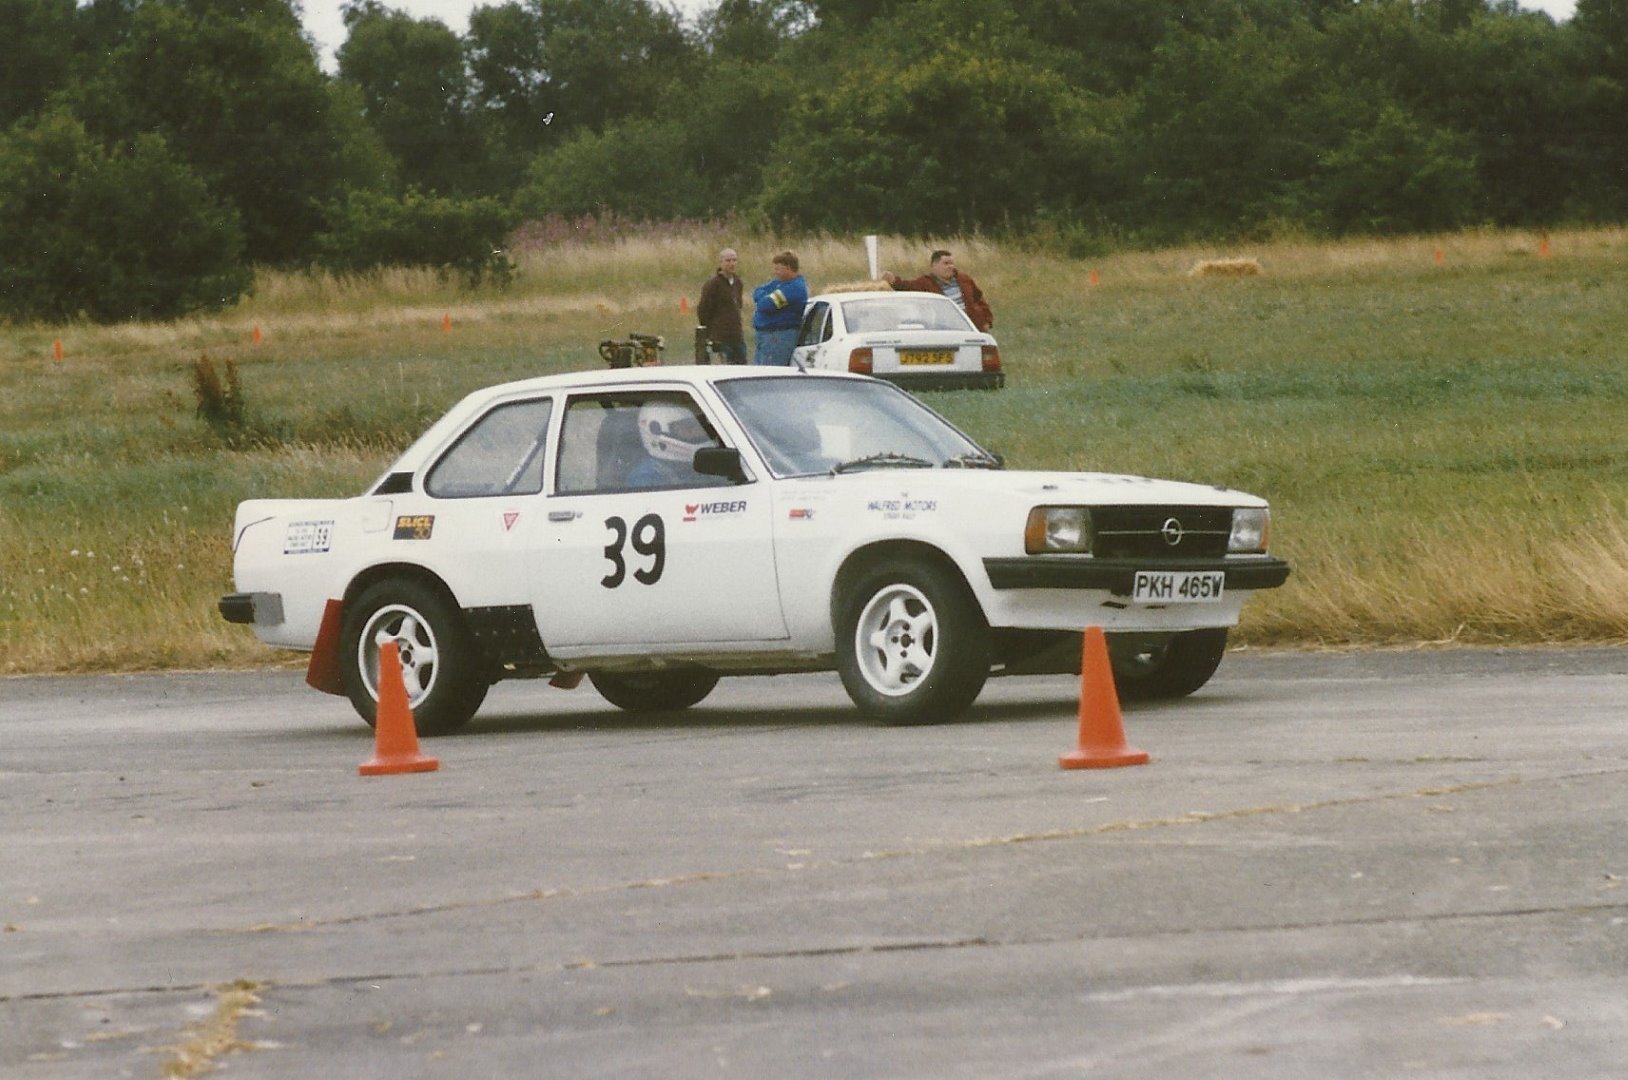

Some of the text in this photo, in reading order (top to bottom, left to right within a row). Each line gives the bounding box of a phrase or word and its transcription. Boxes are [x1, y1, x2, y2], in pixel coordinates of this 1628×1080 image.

[701, 501, 747, 514] WEBER
[904, 500, 937, 511] MOTORS
[600, 513, 666, 589] 39
[1136, 575, 1223, 598] PKH 465W
